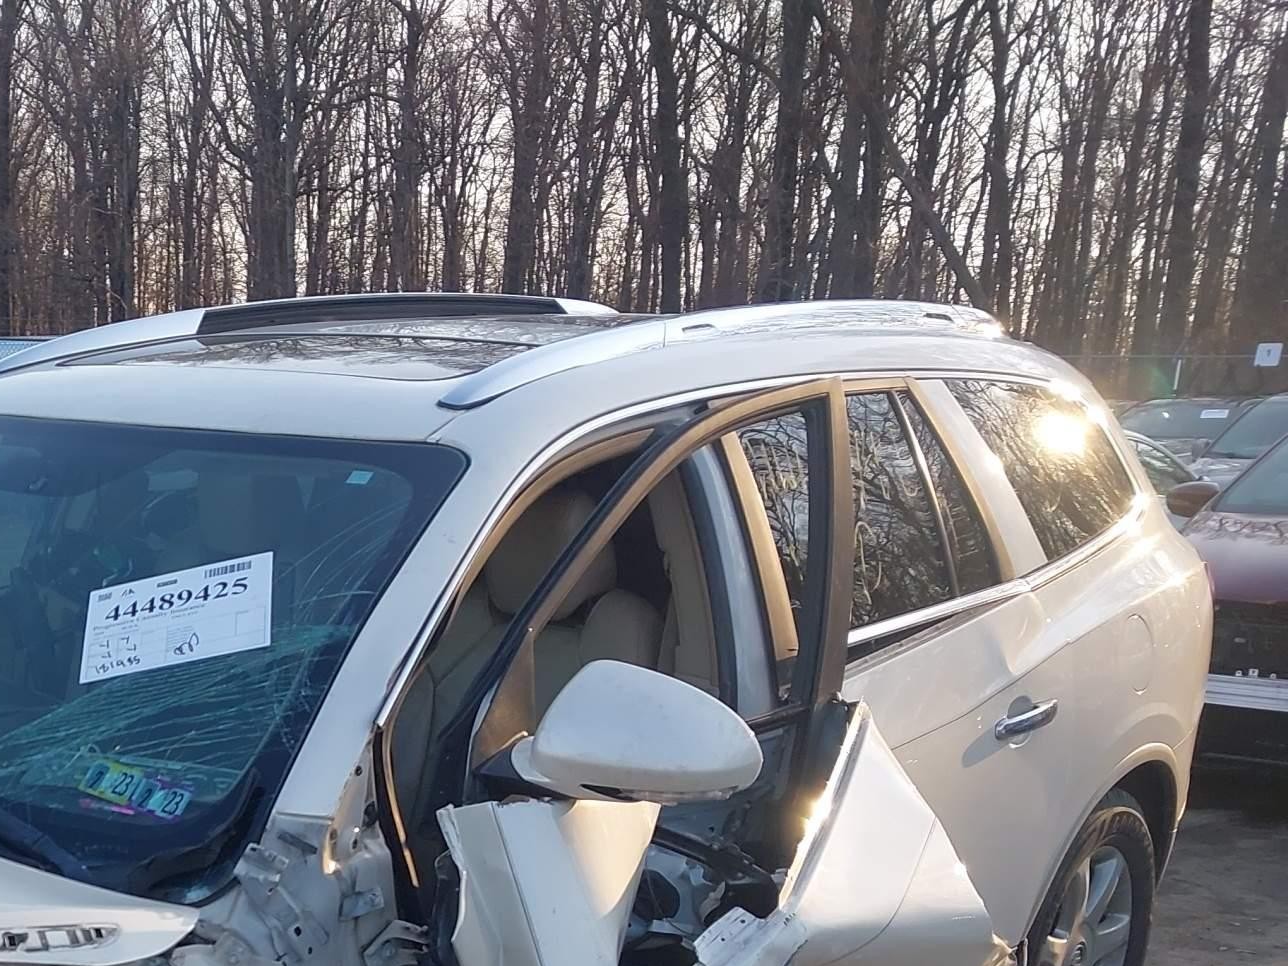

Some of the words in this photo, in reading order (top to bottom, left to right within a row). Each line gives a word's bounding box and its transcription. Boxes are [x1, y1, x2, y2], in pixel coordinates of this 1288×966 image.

[105, 577, 249, 621] 44489425
[112, 772, 135, 796] 23
[138, 788, 153, 808] 2
[162, 791, 184, 815] 23
